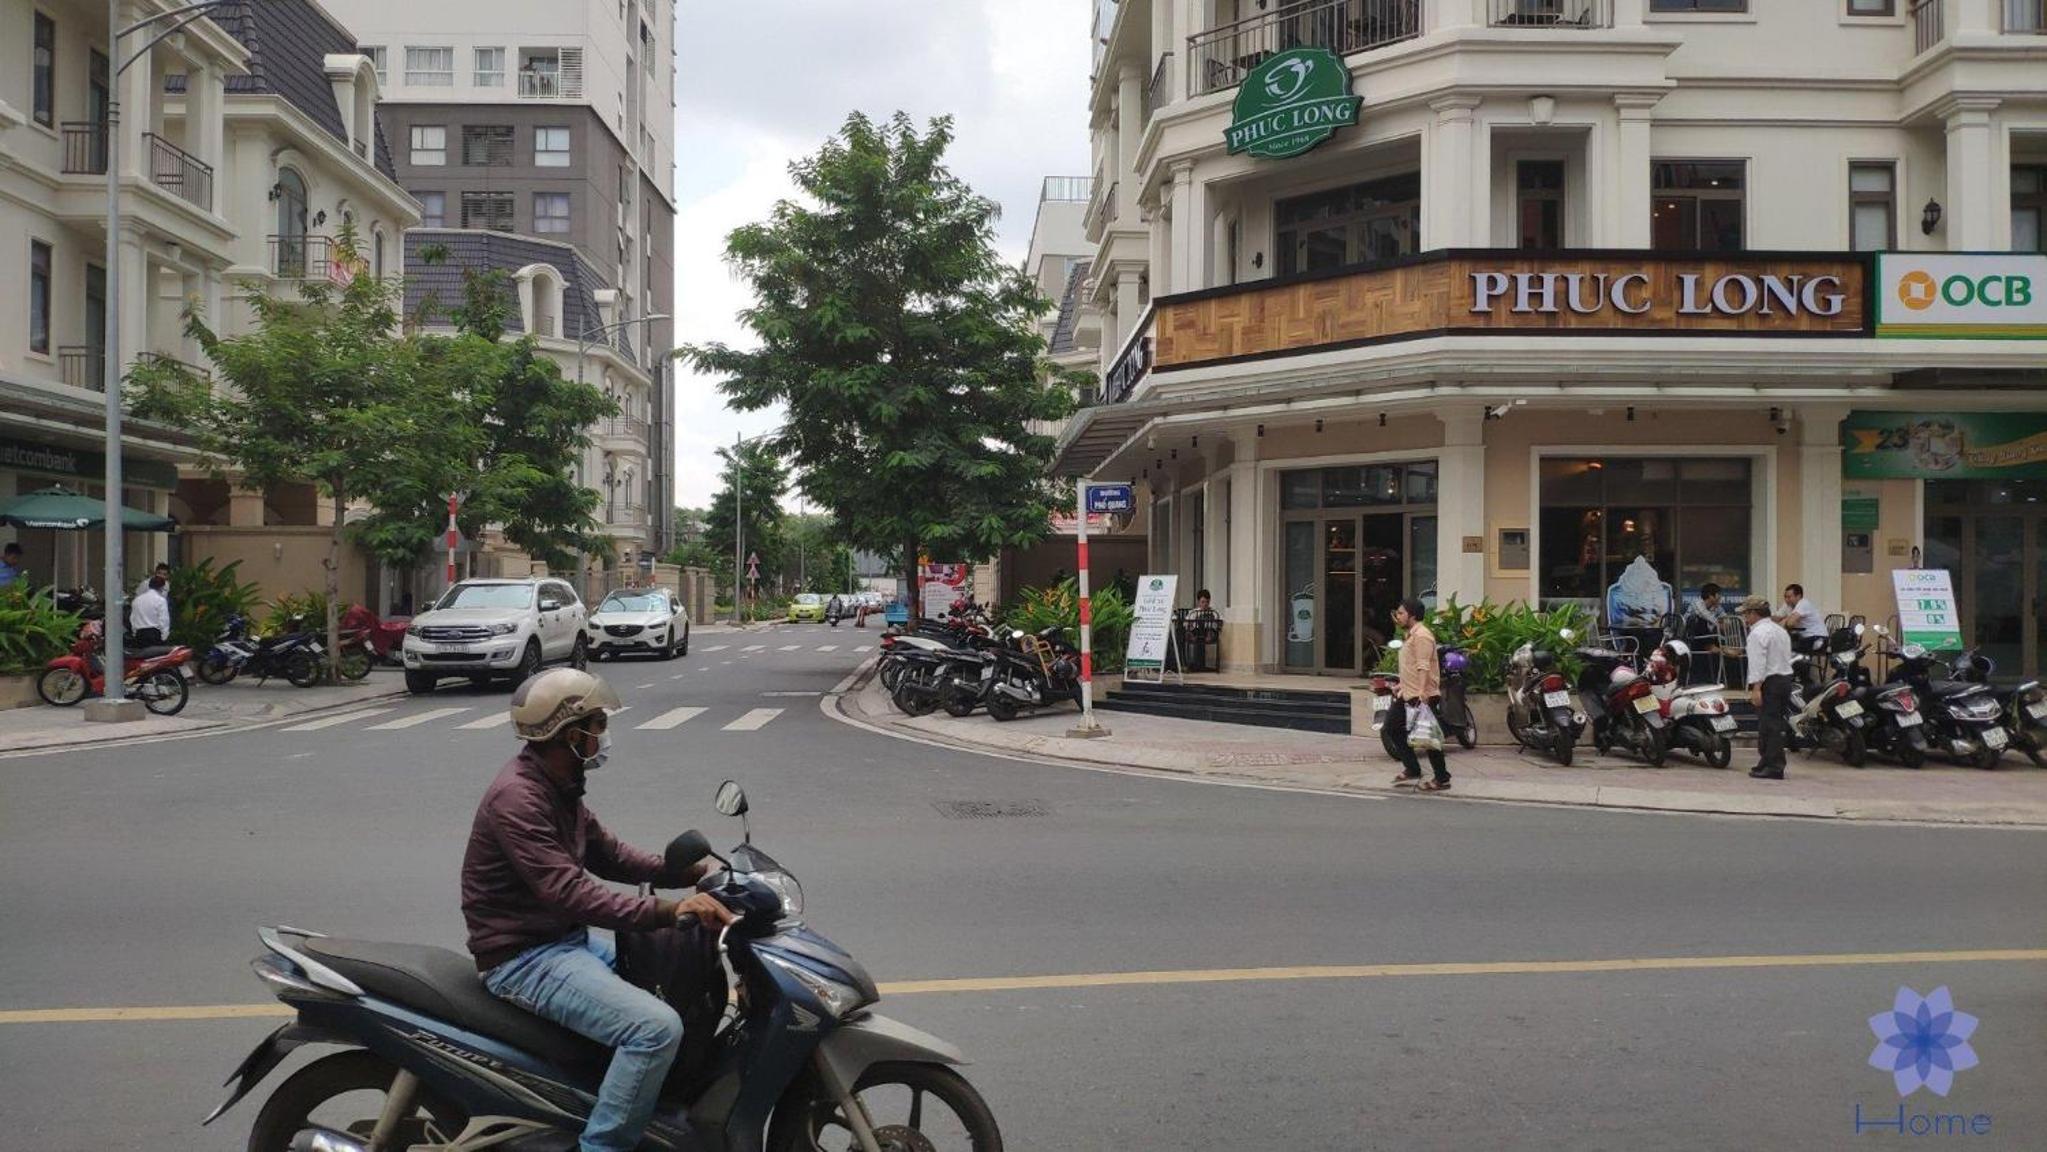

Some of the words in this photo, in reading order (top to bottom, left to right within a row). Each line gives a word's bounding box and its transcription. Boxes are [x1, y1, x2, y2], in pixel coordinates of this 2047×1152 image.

[1231, 114, 1287, 149] PHUC
[1292, 103, 1351, 127] LONG
[1470, 272, 1652, 314] PHUC
[1676, 273, 1845, 316] LONG
[1941, 274, 2033, 307] OCB
